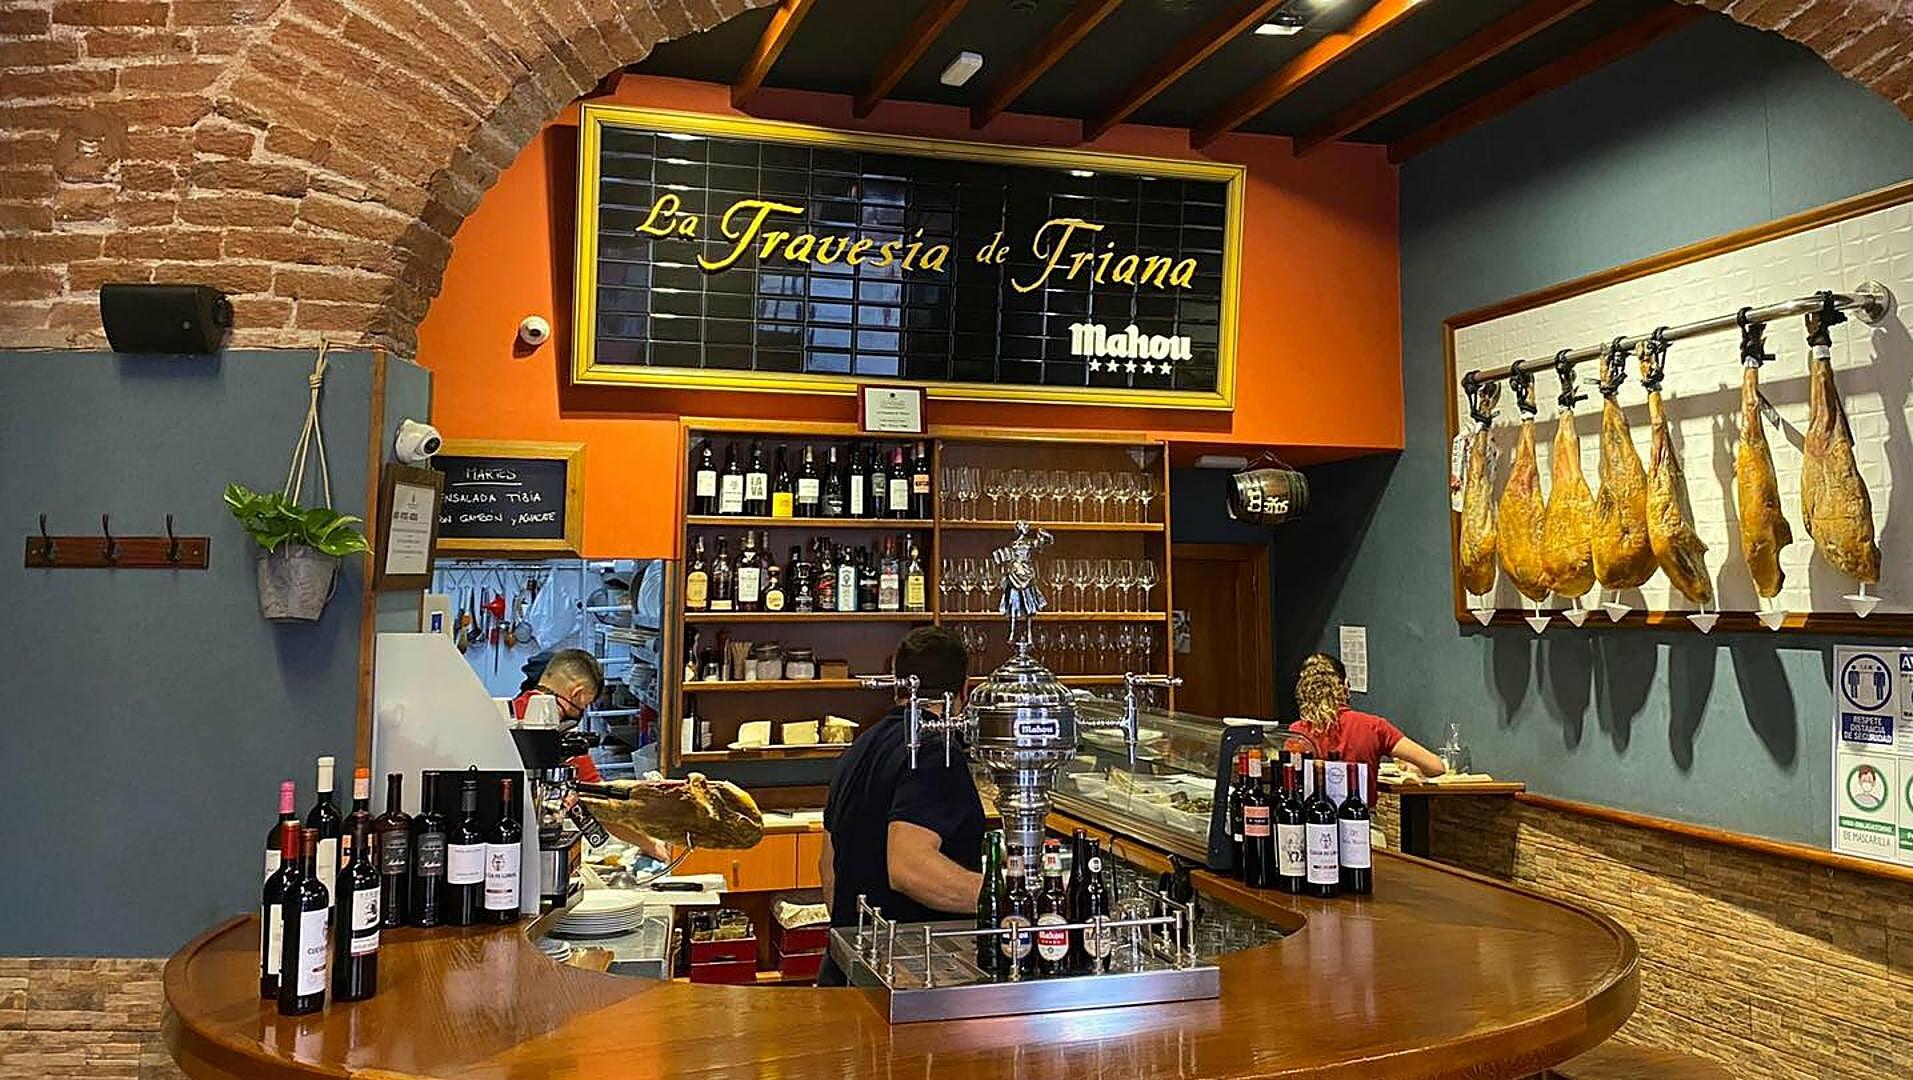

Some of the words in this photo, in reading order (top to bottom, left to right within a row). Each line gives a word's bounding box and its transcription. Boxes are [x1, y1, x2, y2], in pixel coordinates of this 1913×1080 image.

[635, 194, 697, 238] La
[976, 231, 1010, 265] de
[1011, 218, 1198, 293] Triana
[1068, 322, 1193, 361] Mahou
[465, 467, 518, 481] MARTES
[439, 514, 452, 524] ON
